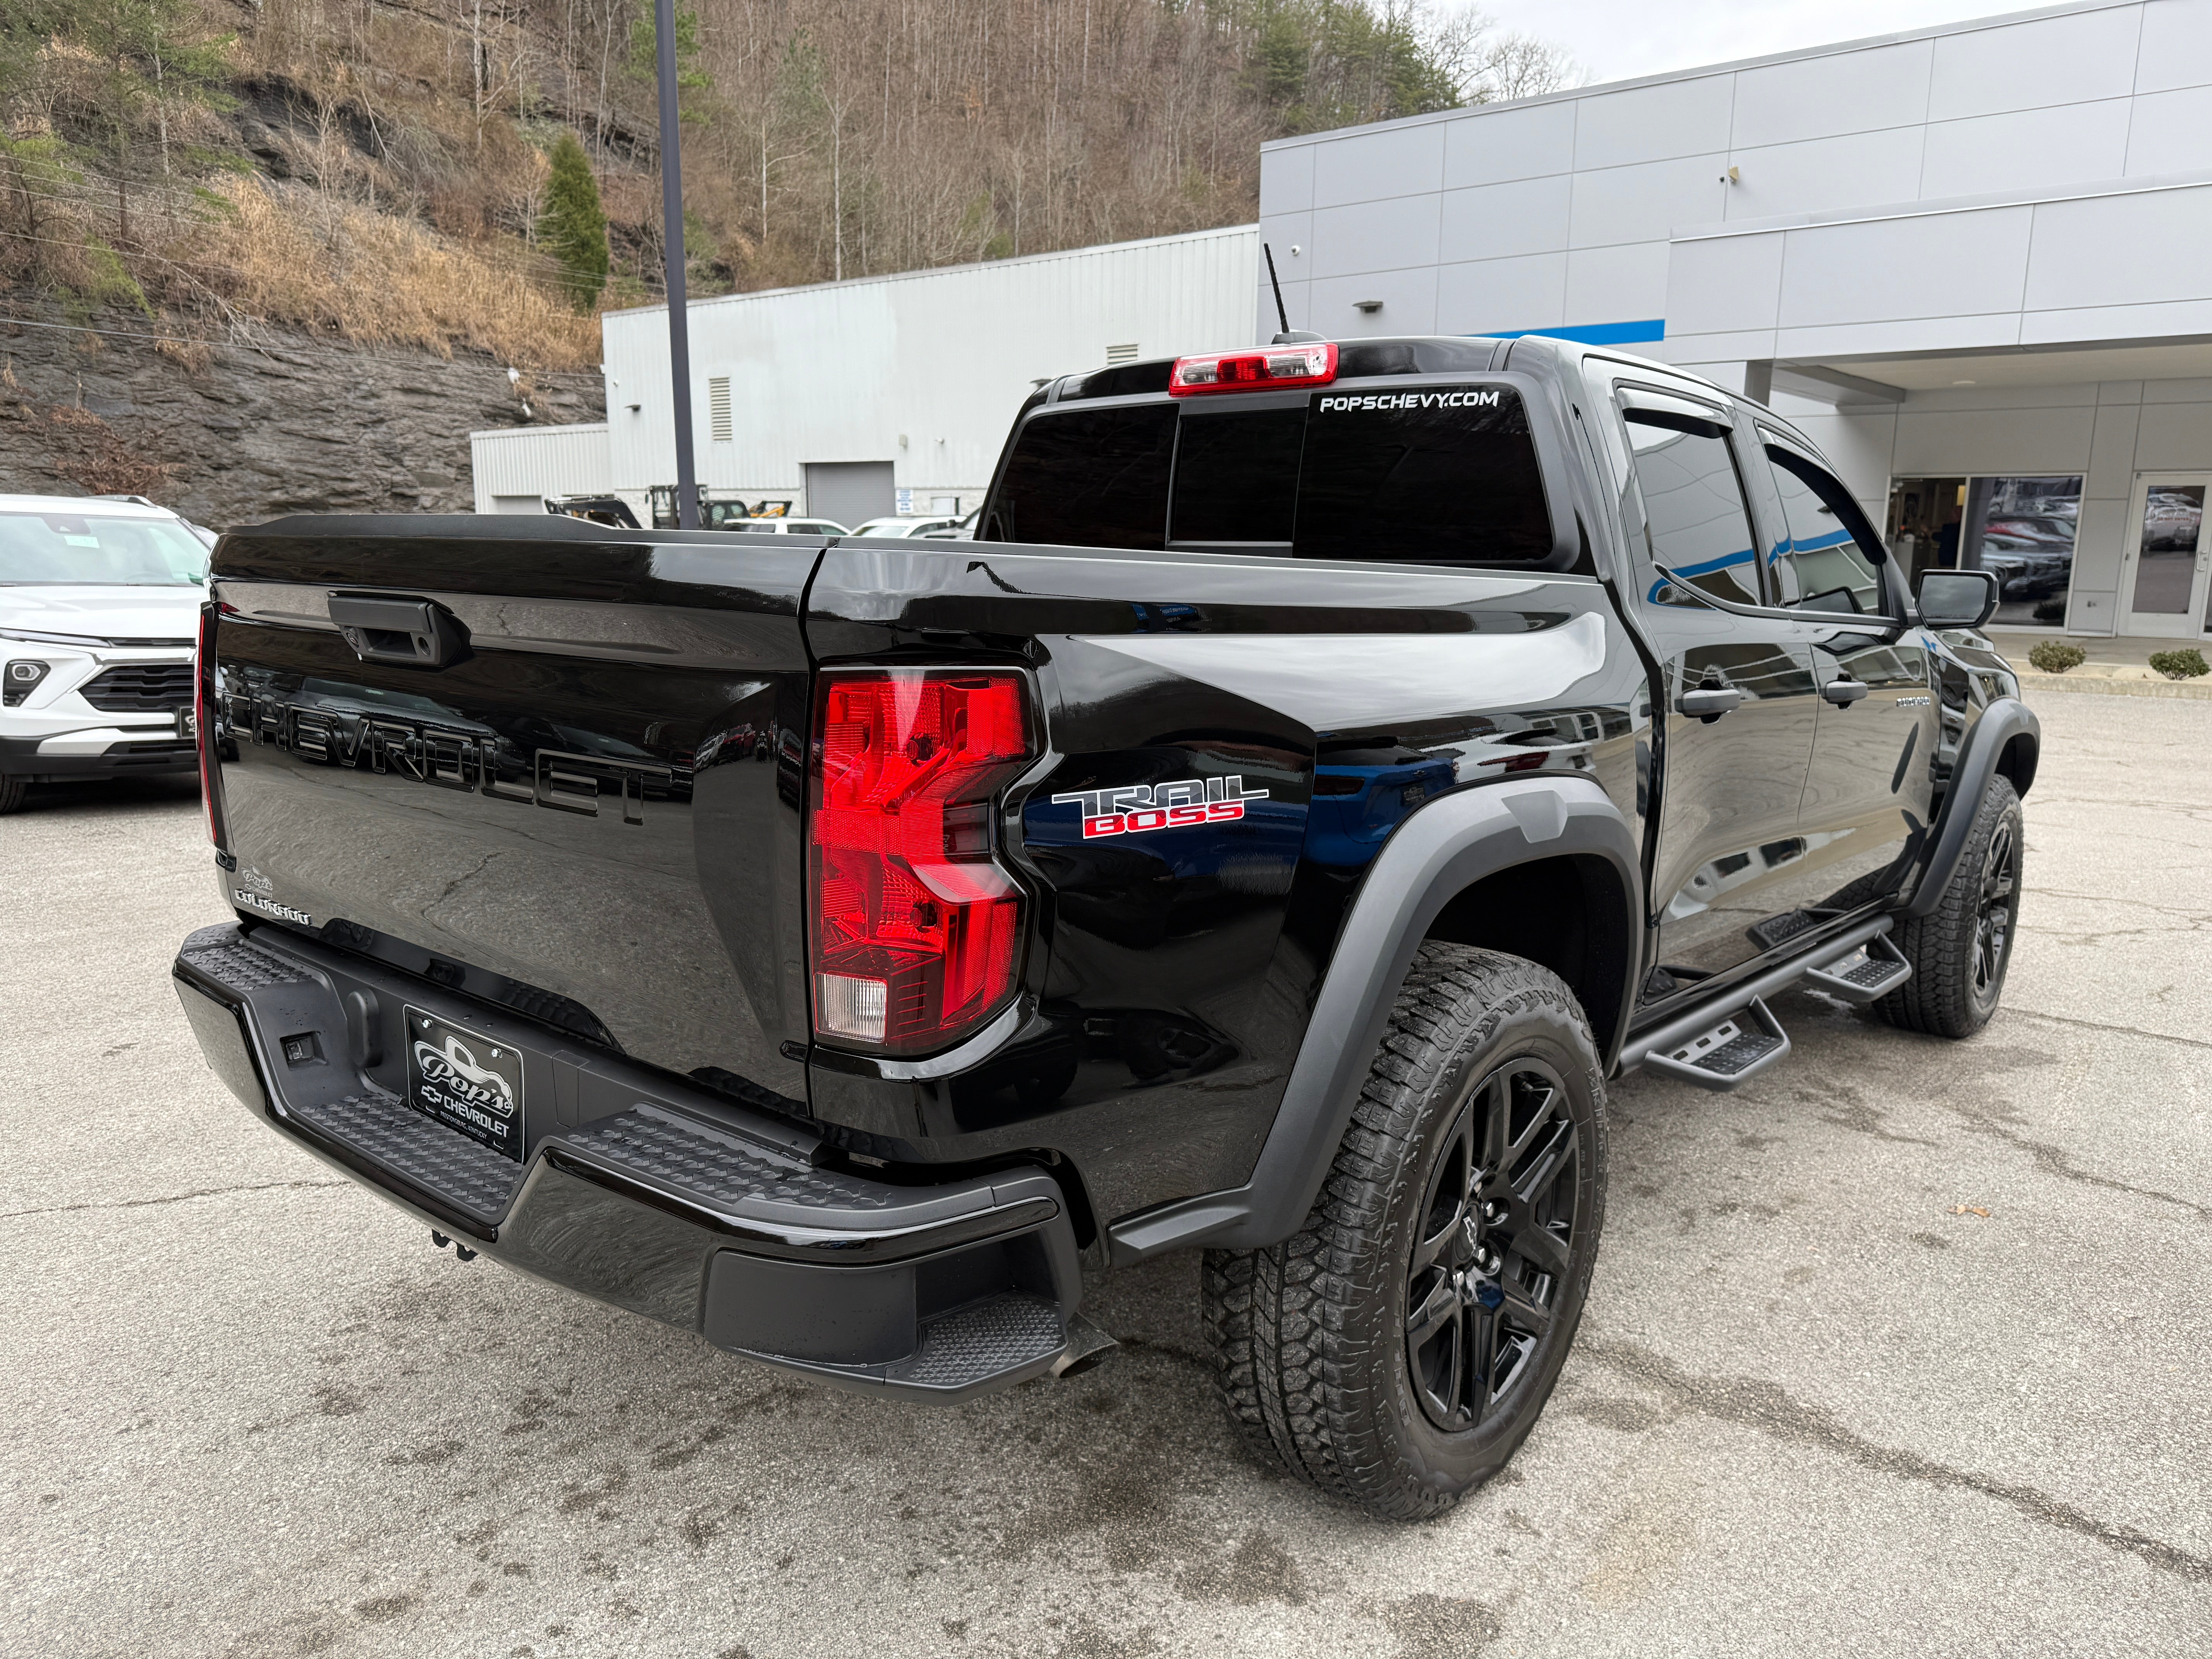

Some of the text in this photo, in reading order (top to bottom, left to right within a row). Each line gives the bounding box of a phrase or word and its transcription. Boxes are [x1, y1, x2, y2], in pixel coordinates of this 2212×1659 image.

[1320, 391, 1499, 413] POPSCHEVY.COM
[222, 691, 672, 825] CHEVROLET
[1051, 775, 1269, 816] TRAIL
[1083, 800, 1245, 839] BOSS
[235, 888, 311, 927] COLORADO
[422, 1055, 508, 1112] Pop's
[444, 1097, 509, 1138] CHEVROLET
[468, 1125, 487, 1140] KENTUCKY
